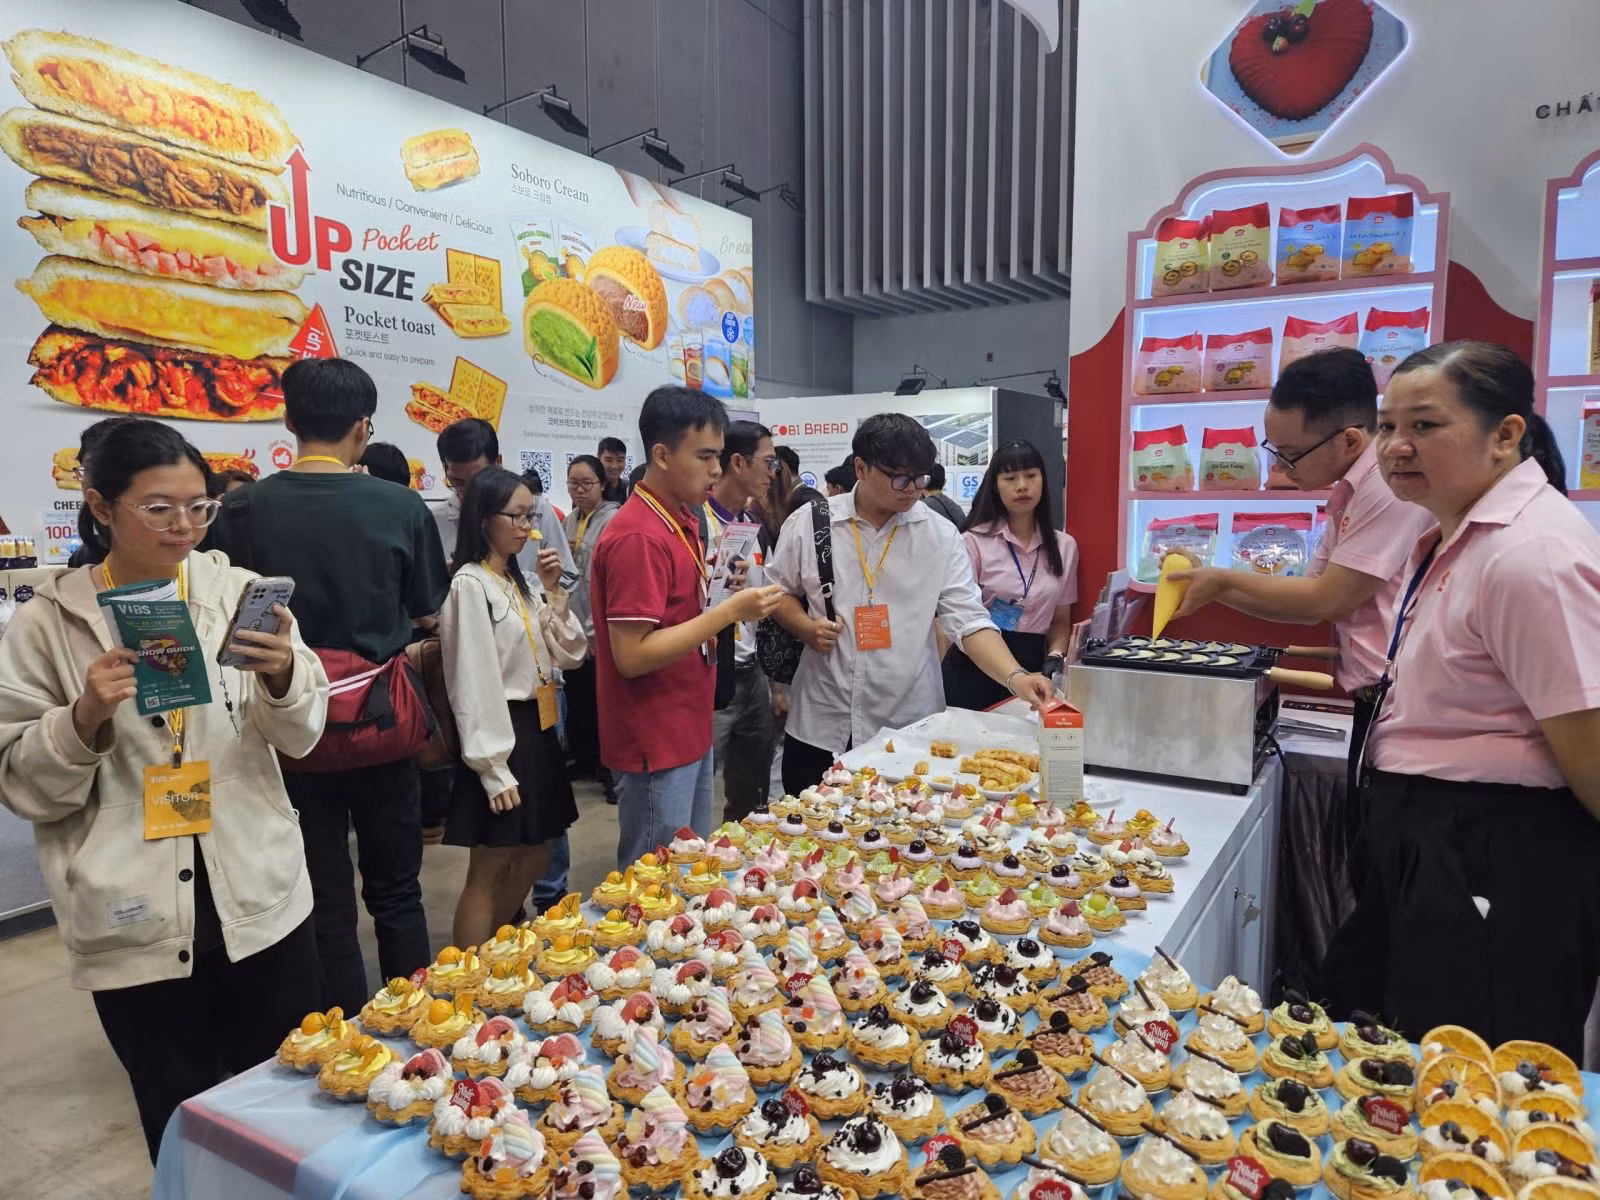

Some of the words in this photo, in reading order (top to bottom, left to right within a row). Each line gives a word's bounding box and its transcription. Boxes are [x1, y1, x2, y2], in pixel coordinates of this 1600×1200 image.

[1535, 92, 1600, 119] CHẤ
[511, 163, 551, 190] Soboro
[554, 179, 589, 203] Cream
[269, 148, 352, 272] UP
[336, 182, 387, 208] Nutritious
[395, 199, 448, 223] Convenient
[455, 214, 494, 236] Delicious
[362, 223, 441, 252] Pocket
[339, 258, 416, 301] SIZE
[623, 294, 648, 311] New
[344, 305, 398, 330] Pocket
[401, 317, 436, 336] toast
[345, 328, 390, 345] 포켓토스트
[345, 346, 367, 358] Quick
[368, 350, 382, 360] and
[383, 352, 400, 364] easy
[401, 354, 409, 363] to
[409, 356, 436, 366] prepare
[771, 424, 800, 436] COBI
[804, 422, 849, 435] BREAD
[962, 476, 978, 487] GS
[54, 501, 82, 511] CHEE
[45, 525, 72, 540] 100
[117, 604, 151, 615] VIBS
[136, 648, 165, 657] SHOW
[166, 645, 196, 654] GUIDE
[152, 791, 199, 806] VISITOR
[1371, 1103, 1401, 1123] Nhất
[1234, 1159, 1264, 1183] Nhất
